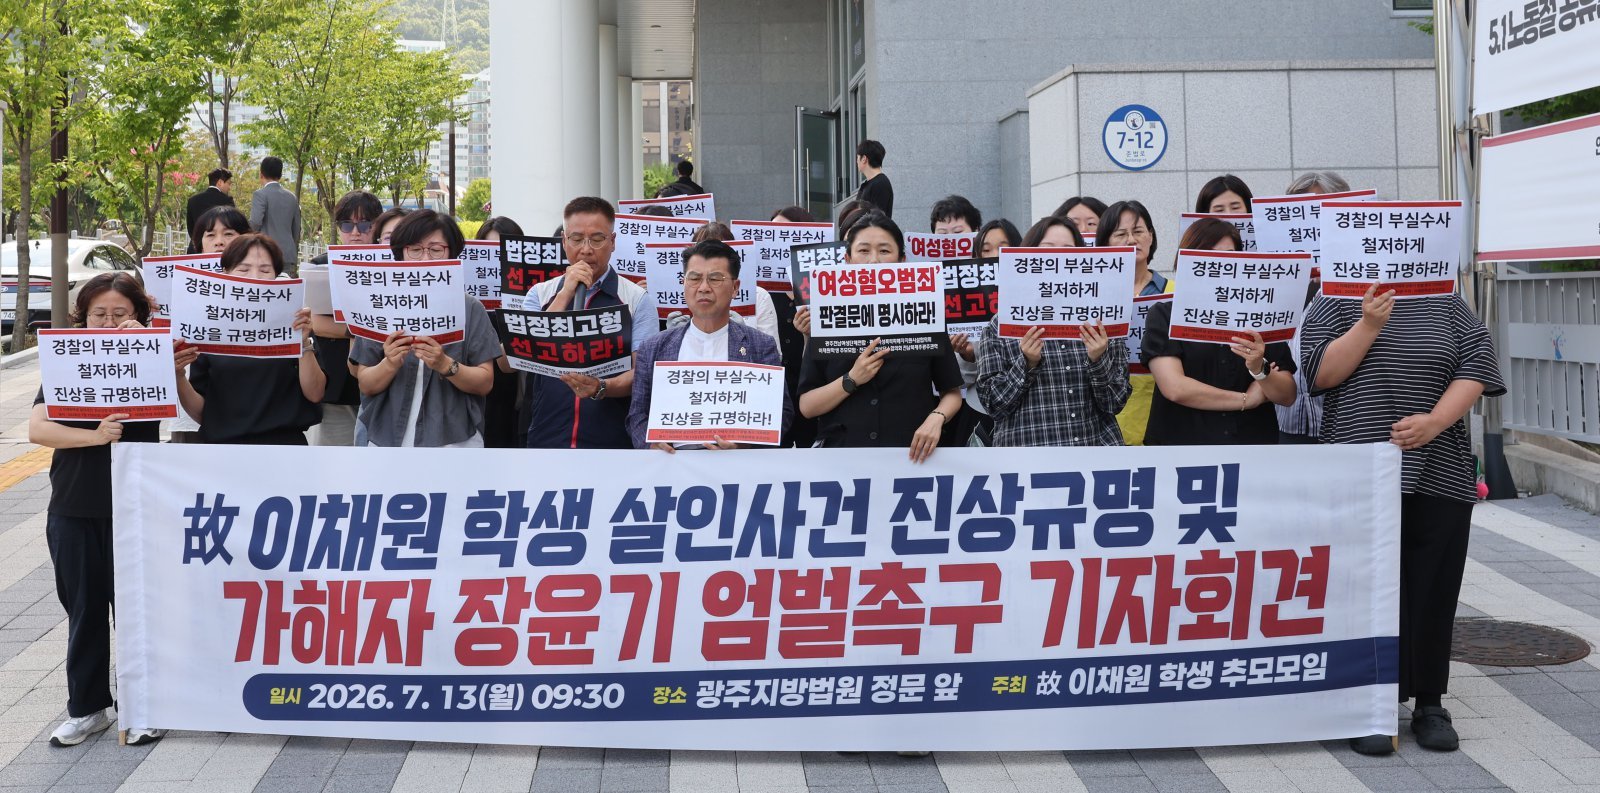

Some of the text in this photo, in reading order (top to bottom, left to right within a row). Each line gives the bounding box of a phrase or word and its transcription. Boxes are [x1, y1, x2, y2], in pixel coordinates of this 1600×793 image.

[1117, 131, 1154, 149] 7-12
[667, 201, 706, 216] 실수사
[1264, 205, 1305, 222] 경찰의
[1335, 211, 1383, 228] 경찰의
[1388, 211, 1451, 228] 부실수사
[619, 222, 652, 237] 경찰의
[741, 228, 825, 243] 경찰의 부실수사
[1288, 227, 1320, 243] 철저
[505, 239, 570, 265] 법정최
[1361, 236, 1425, 254] 철저하게
[616, 258, 647, 274] 진상을
[656, 251, 683, 265] 경찰
[1013, 256, 1124, 274] 경찰의 부실수사
[1191, 260, 1301, 280] 경찰의 부실수사
[1332, 260, 1449, 279] 진상을 규명하라!
[345, 270, 452, 287] 경찰의 부실수사
[184, 276, 292, 302] 경찰의 부실수사
[1038, 281, 1099, 298] 철저하게
[1214, 286, 1274, 303] 철저하게
[369, 293, 428, 310] 철저하게
[205, 304, 266, 323] 철저하게
[350, 311, 456, 332] 진상을 규명하라!
[819, 301, 936, 329] 판결문에 명시하라!
[1010, 305, 1055, 321] 진상을
[1059, 305, 1124, 322] 규명하라!
[1183, 308, 1294, 328] 진상을 규명하라!
[179, 322, 293, 343] 진상을 규명하라!
[503, 310, 623, 338] 법정최고형
[52, 338, 160, 355] 경찰의 부실수사
[510, 335, 624, 364] 선고하라!
[77, 363, 137, 379] 철저하게
[666, 369, 773, 385] 경찰의 부실수사
[54, 386, 167, 403] 진상을 규명하라!
[688, 390, 747, 406] 철저하게
[660, 411, 772, 426] 진상을 규명하라!
[182, 463, 1240, 572] 故 이채원 학생 살인사건 진상규명 및
[223, 546, 1330, 666] 가해자 장윤기 엄벌촉구 기자회견
[270, 652, 1329, 711] 일시 2026. 7. 13(월) 09:30 장소 광주지방법원 정문 앞 주최 故 이채원 학생 추모모임
